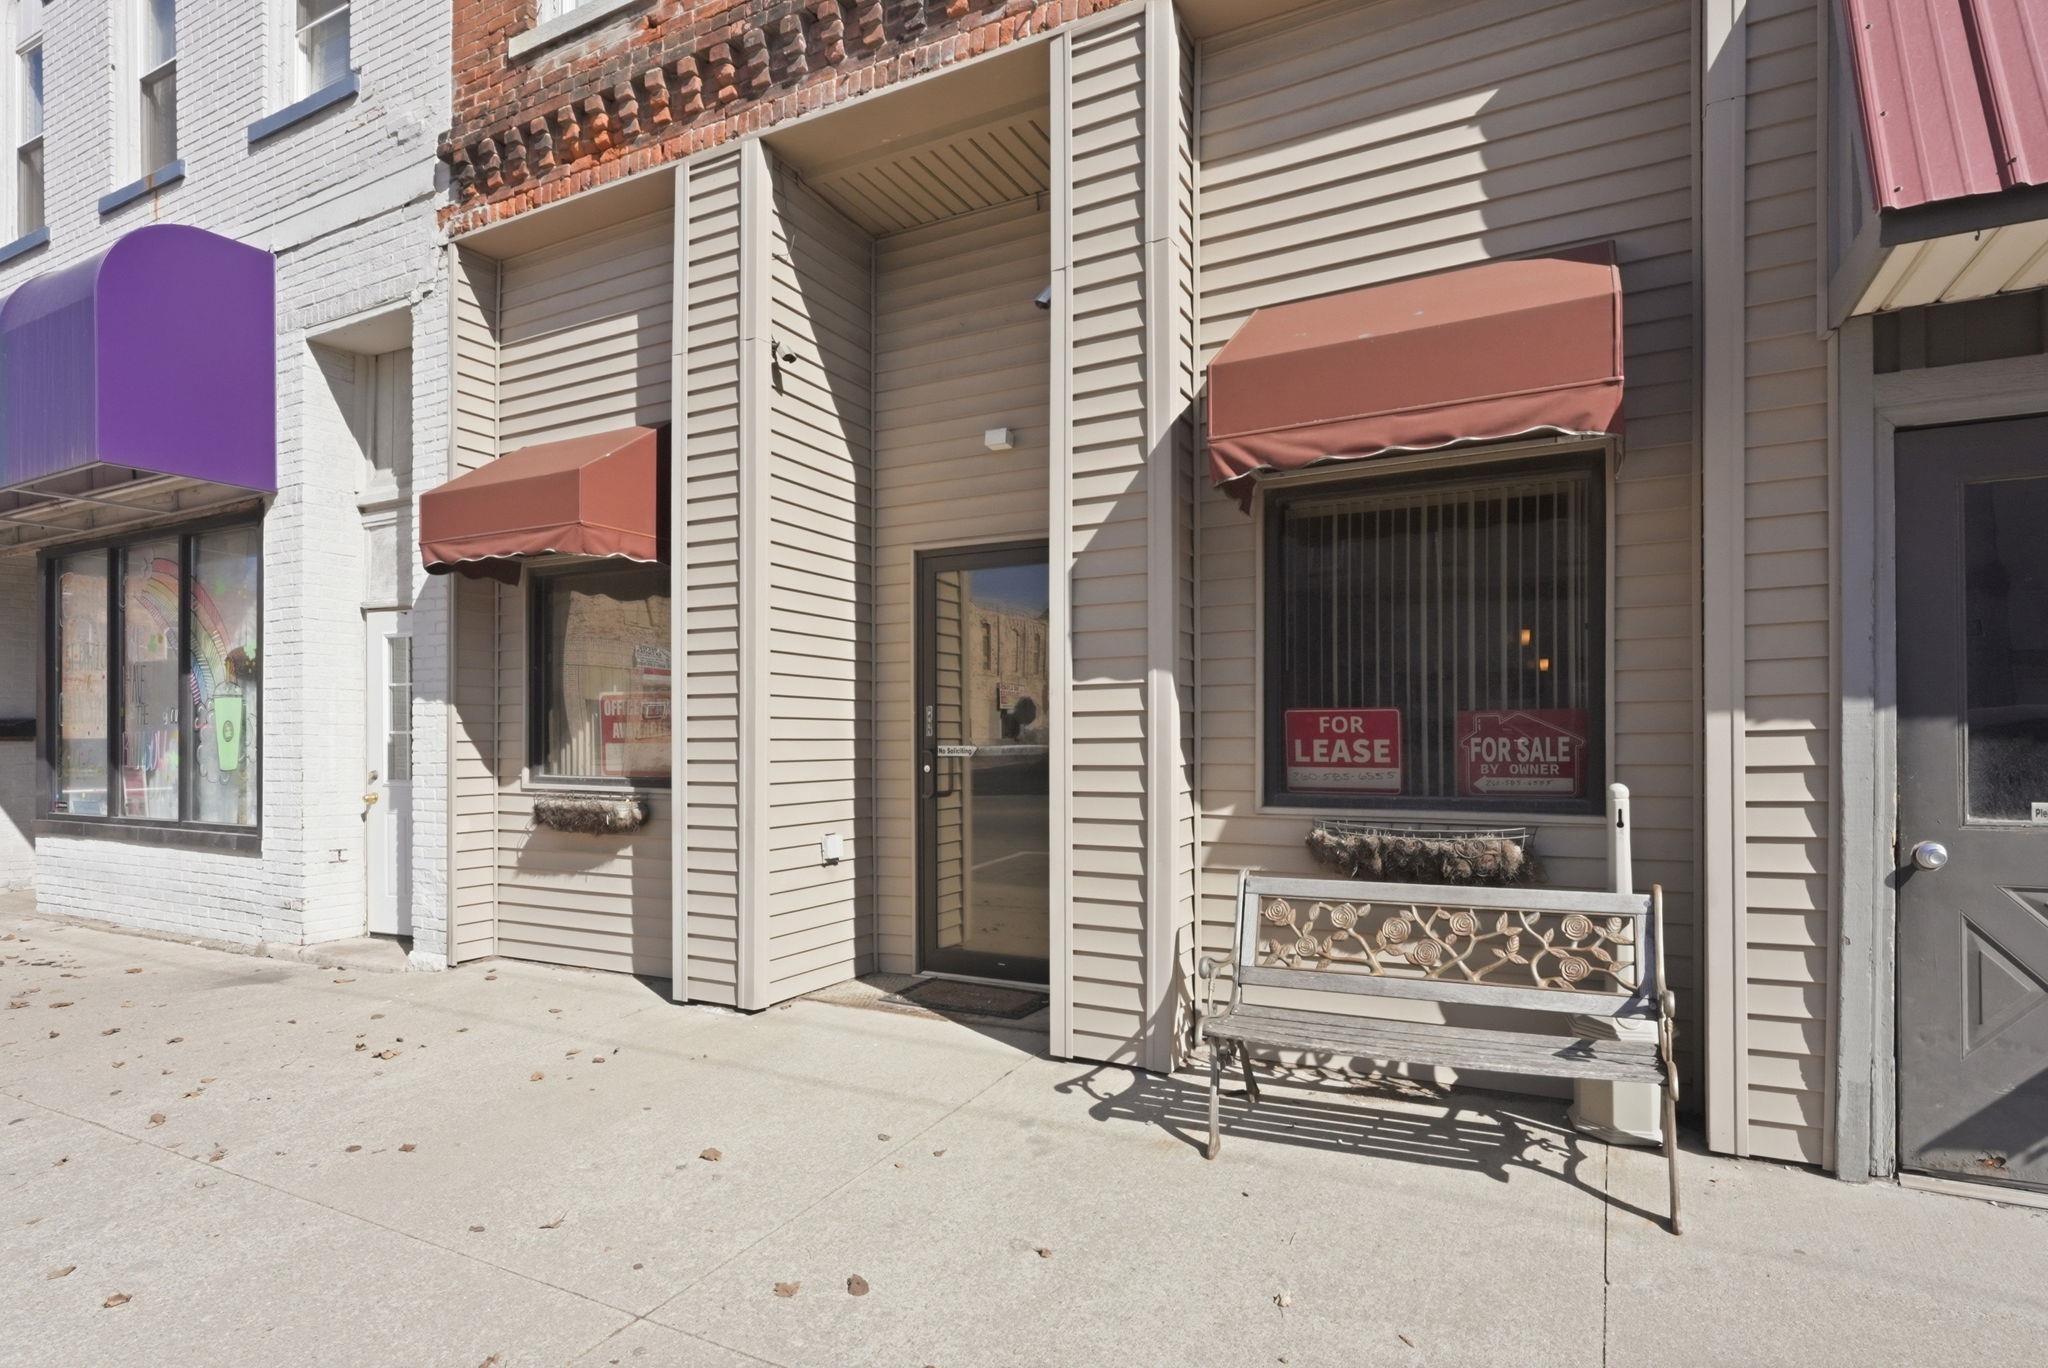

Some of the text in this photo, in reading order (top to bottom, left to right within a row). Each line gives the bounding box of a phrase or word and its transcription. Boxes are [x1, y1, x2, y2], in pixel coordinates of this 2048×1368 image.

[1319, 716, 1364, 734] FOR
[938, 747, 972, 756] No Soliciting
[1294, 739, 1392, 763] LEASE
[1470, 736, 1571, 762] FOR SALE
[1480, 764, 1560, 775] BY OWNER
